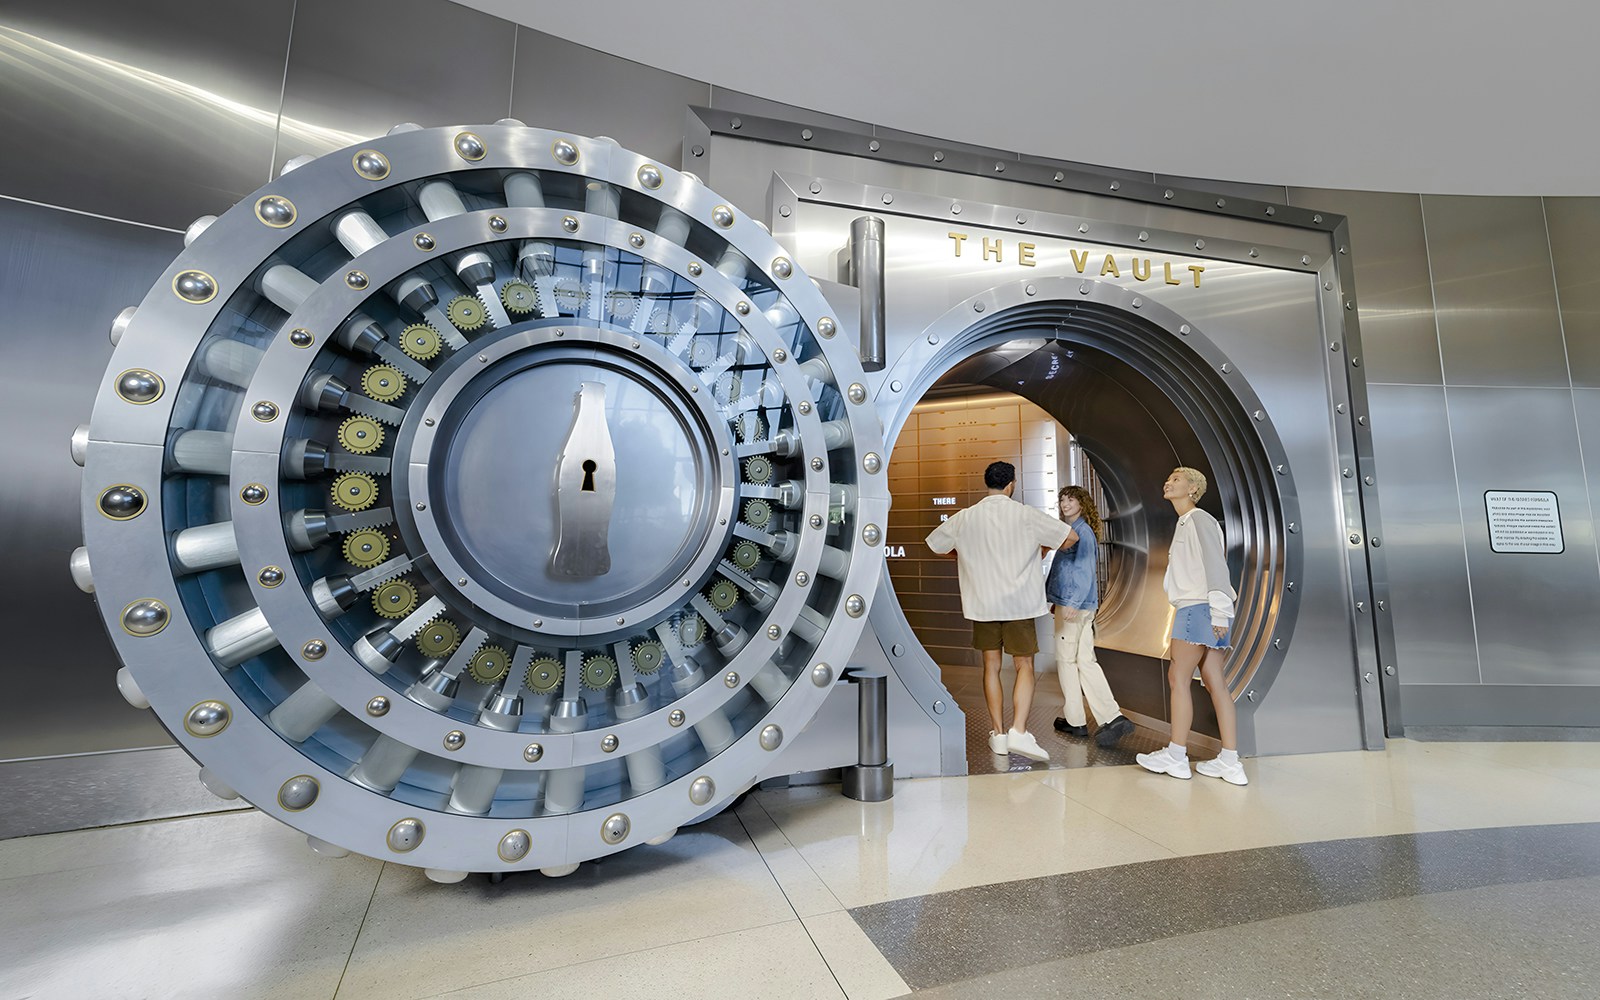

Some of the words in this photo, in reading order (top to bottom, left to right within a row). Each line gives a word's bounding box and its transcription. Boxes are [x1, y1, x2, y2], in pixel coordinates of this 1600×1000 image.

[948, 232, 1036, 266] THE
[1070, 249, 1205, 288] VAULT
[932, 497, 956, 505] THERE
[940, 514, 949, 522] IS
